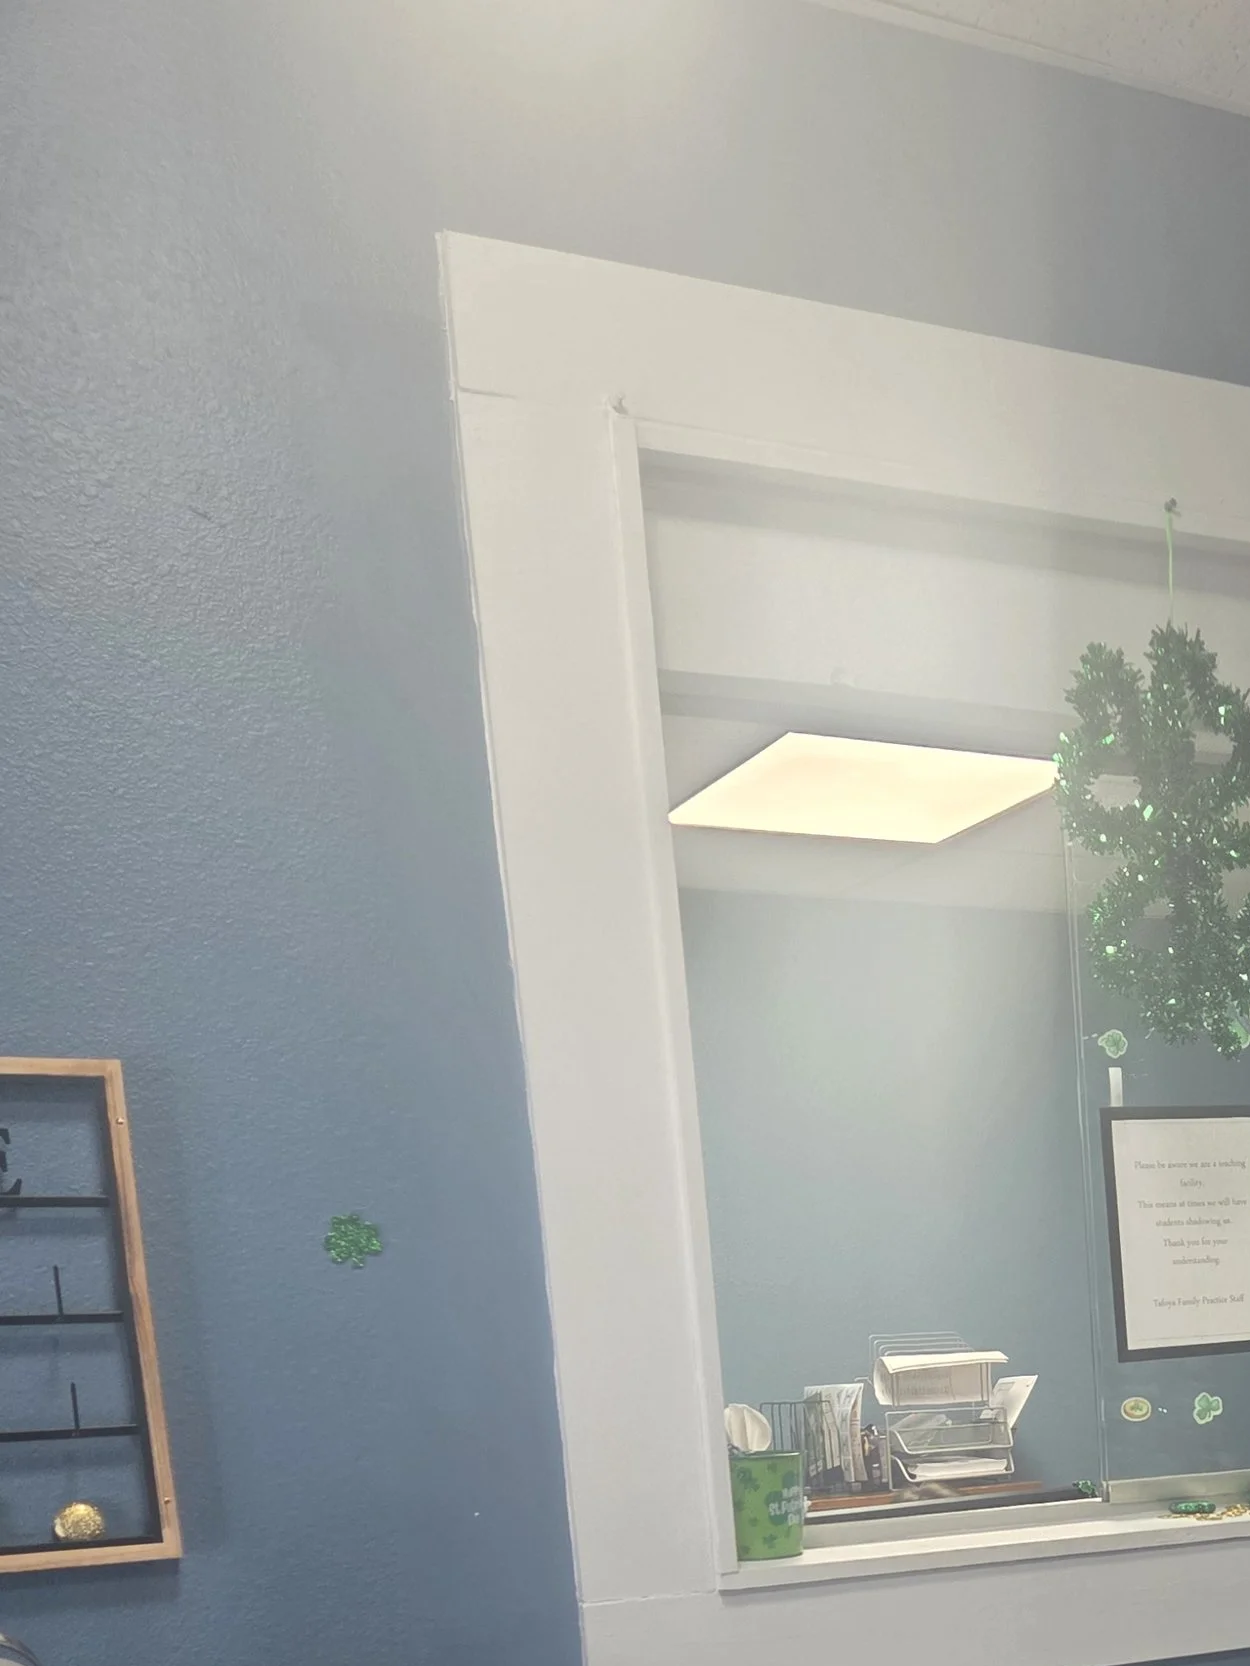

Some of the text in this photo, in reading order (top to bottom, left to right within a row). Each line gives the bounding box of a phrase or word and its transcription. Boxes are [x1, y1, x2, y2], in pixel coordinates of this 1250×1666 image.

[1135, 1161, 1155, 1169] Please
[1158, 1160, 1165, 1169] be
[1219, 1159, 1246, 1169] teaching
[1138, 1200, 1153, 1208] This
[1187, 1199, 1205, 1207] times
[1218, 1197, 1230, 1206] will
[1232, 1197, 1247, 1205] have
[1156, 1218, 1184, 1226] students
[1186, 1217, 1221, 1227] shadowing
[1164, 1236, 1228, 1248] Thank you for your
[1153, 1294, 1244, 1309] Tafoya Family Practice Staff
